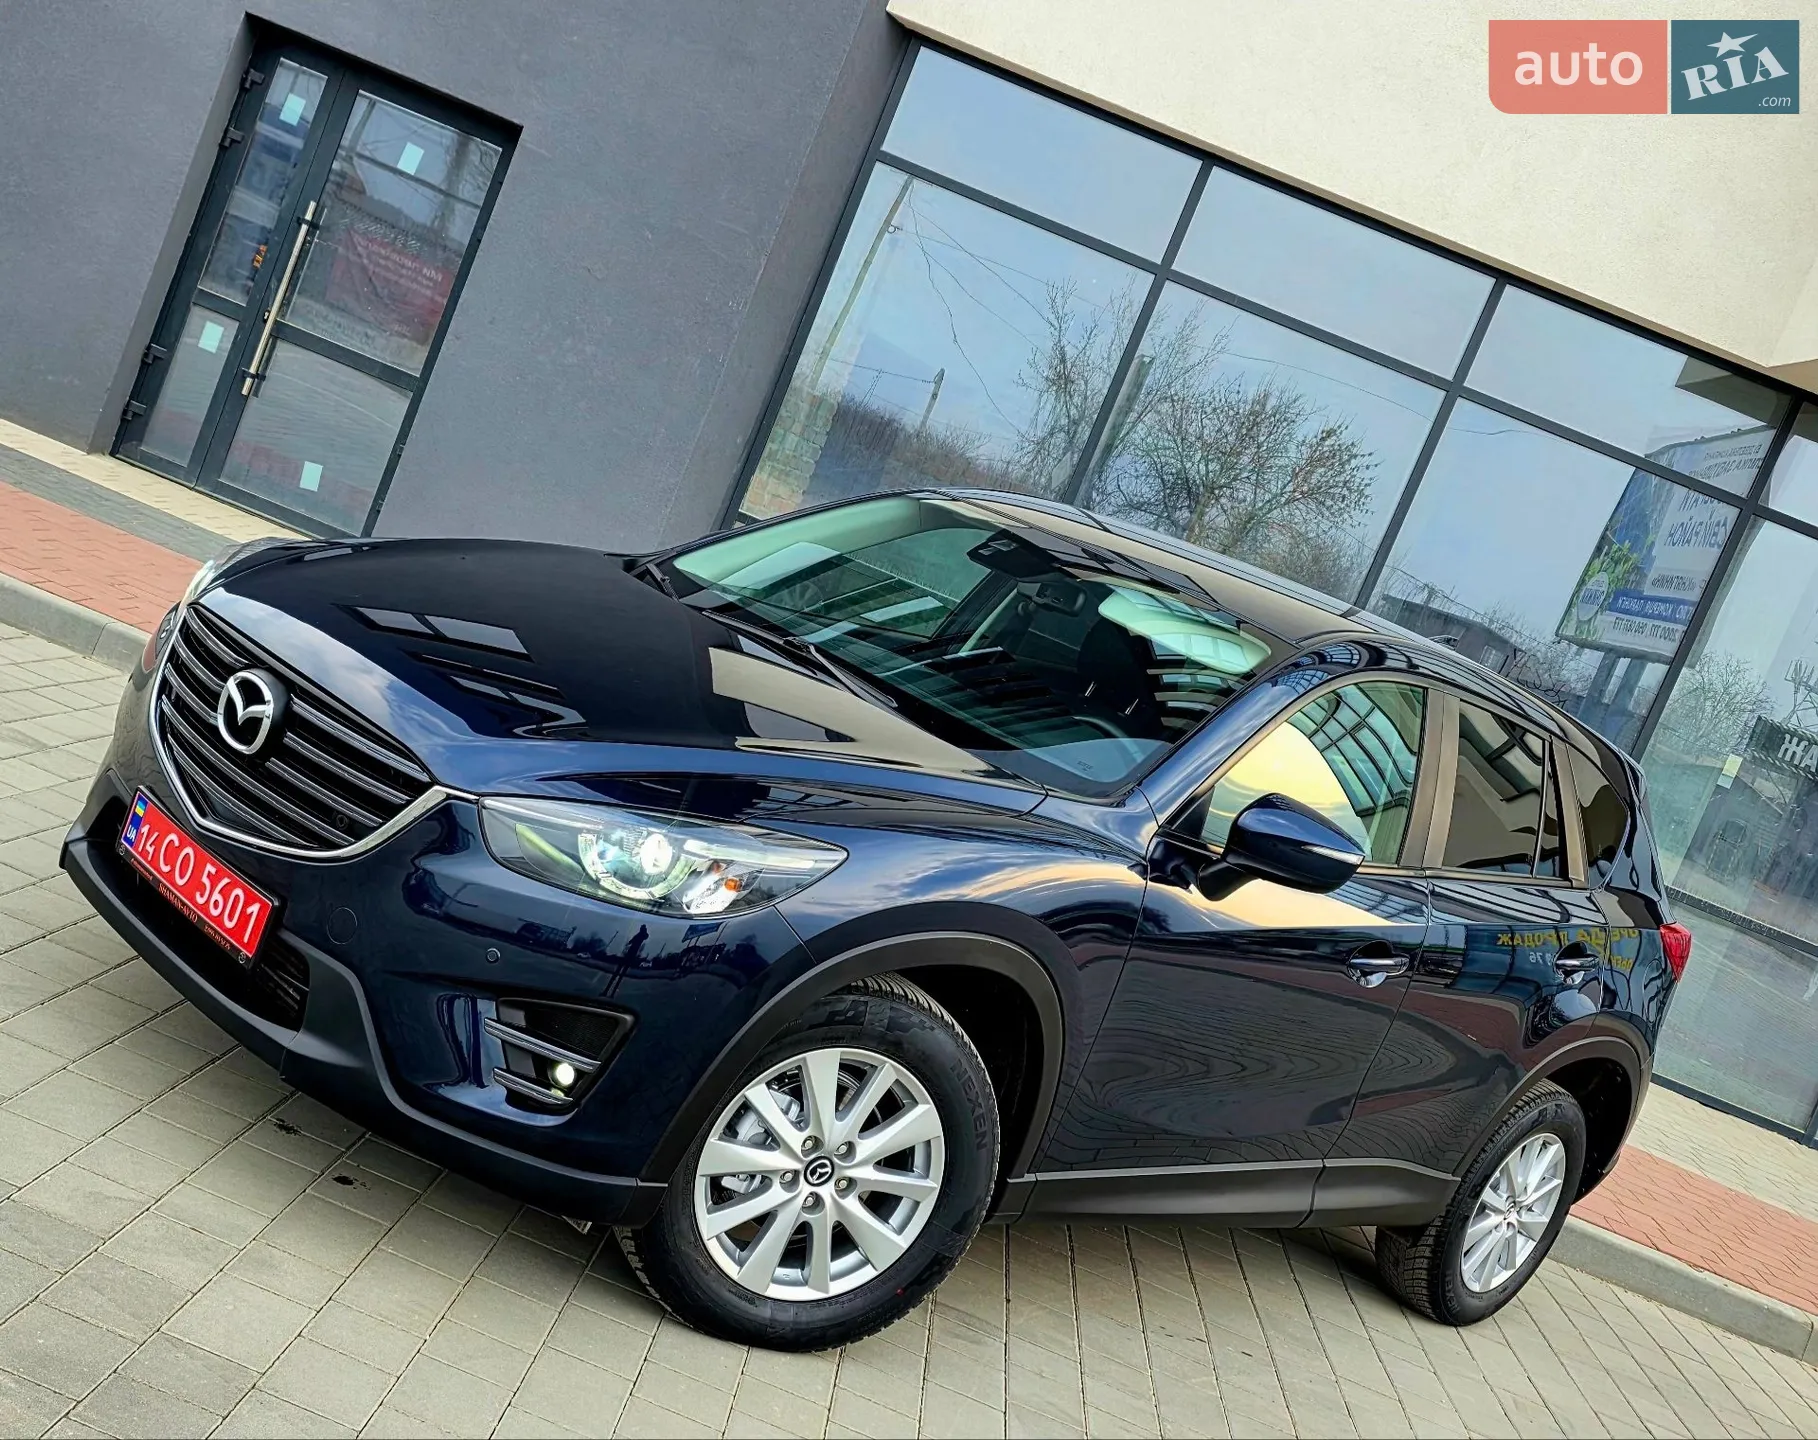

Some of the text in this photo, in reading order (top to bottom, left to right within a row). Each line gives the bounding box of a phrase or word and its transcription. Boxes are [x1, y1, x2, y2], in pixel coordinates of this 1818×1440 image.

[127, 825, 136, 843] UA
[138, 824, 160, 861] 14
[159, 832, 196, 887] CO
[195, 862, 262, 944] 5601
[949, 1058, 989, 1151] NEXEN
